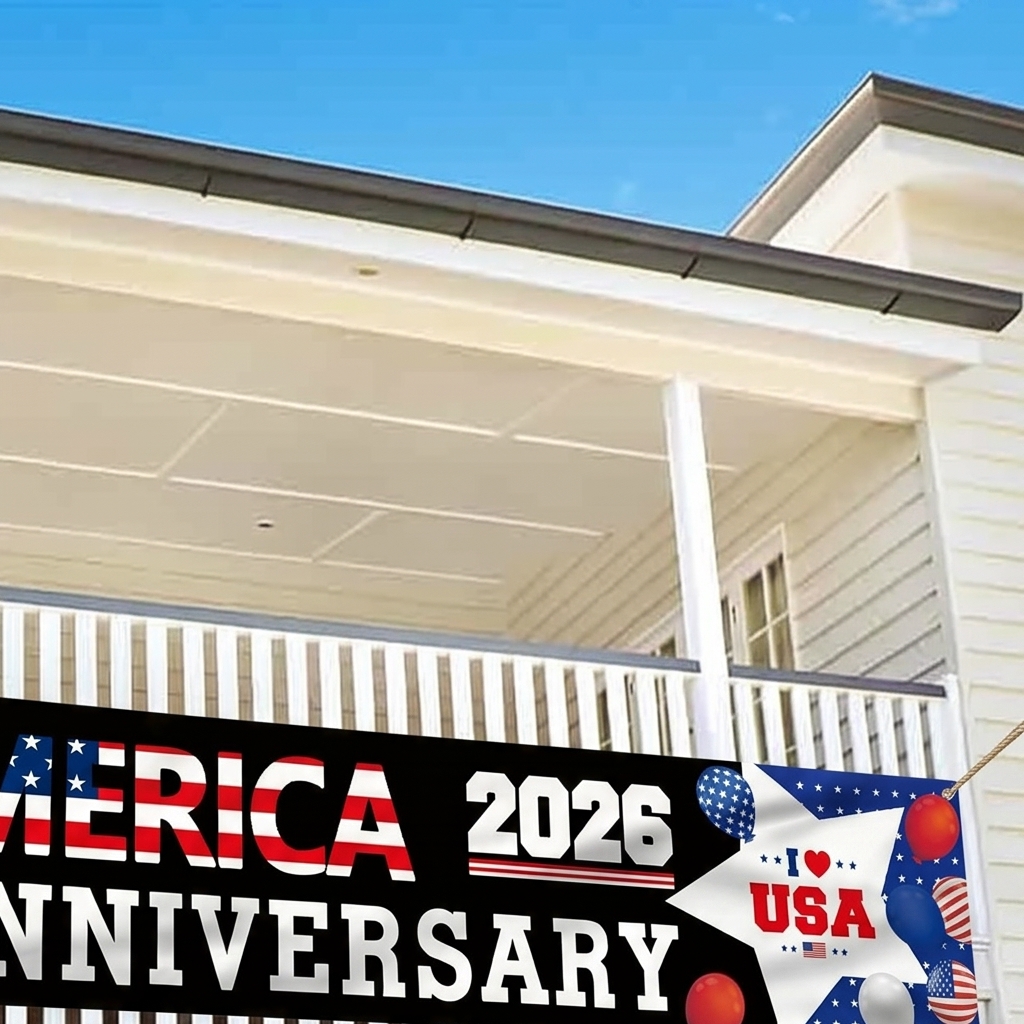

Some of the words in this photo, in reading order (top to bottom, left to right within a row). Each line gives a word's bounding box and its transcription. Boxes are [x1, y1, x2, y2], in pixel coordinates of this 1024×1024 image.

[466, 771, 674, 866] 2026
[786, 847, 800, 877] I
[749, 882, 877, 940] USA
